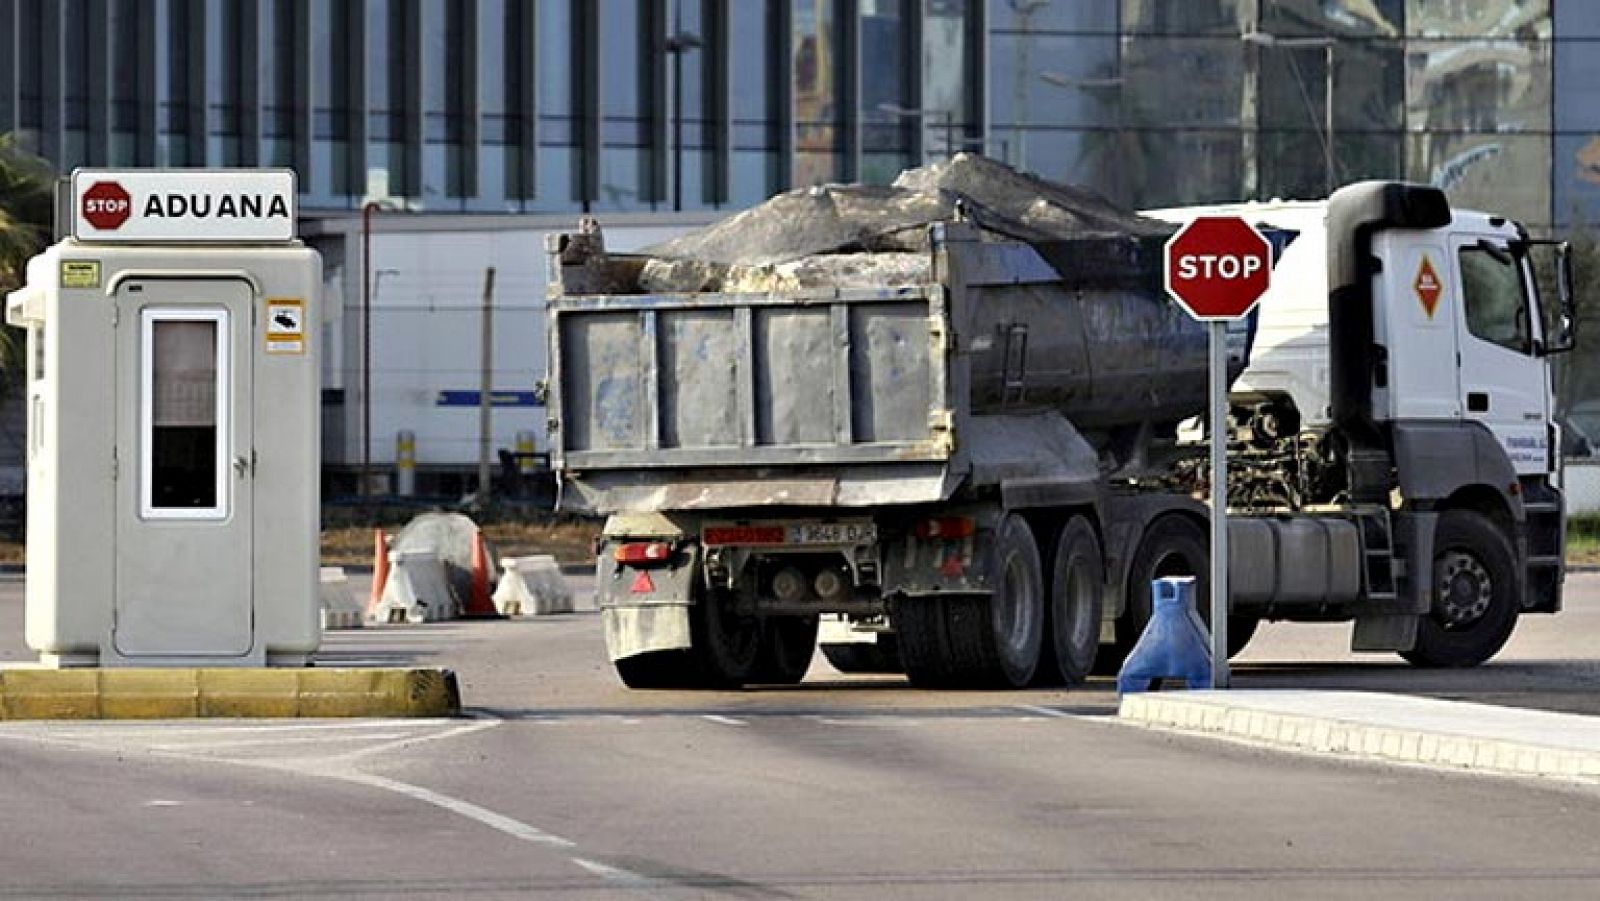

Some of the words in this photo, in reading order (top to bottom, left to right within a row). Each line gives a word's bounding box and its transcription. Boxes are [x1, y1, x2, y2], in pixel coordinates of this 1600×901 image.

[86, 199, 128, 213] STOP
[144, 193, 289, 218] ADUANA
[1178, 254, 1262, 279] STOP
